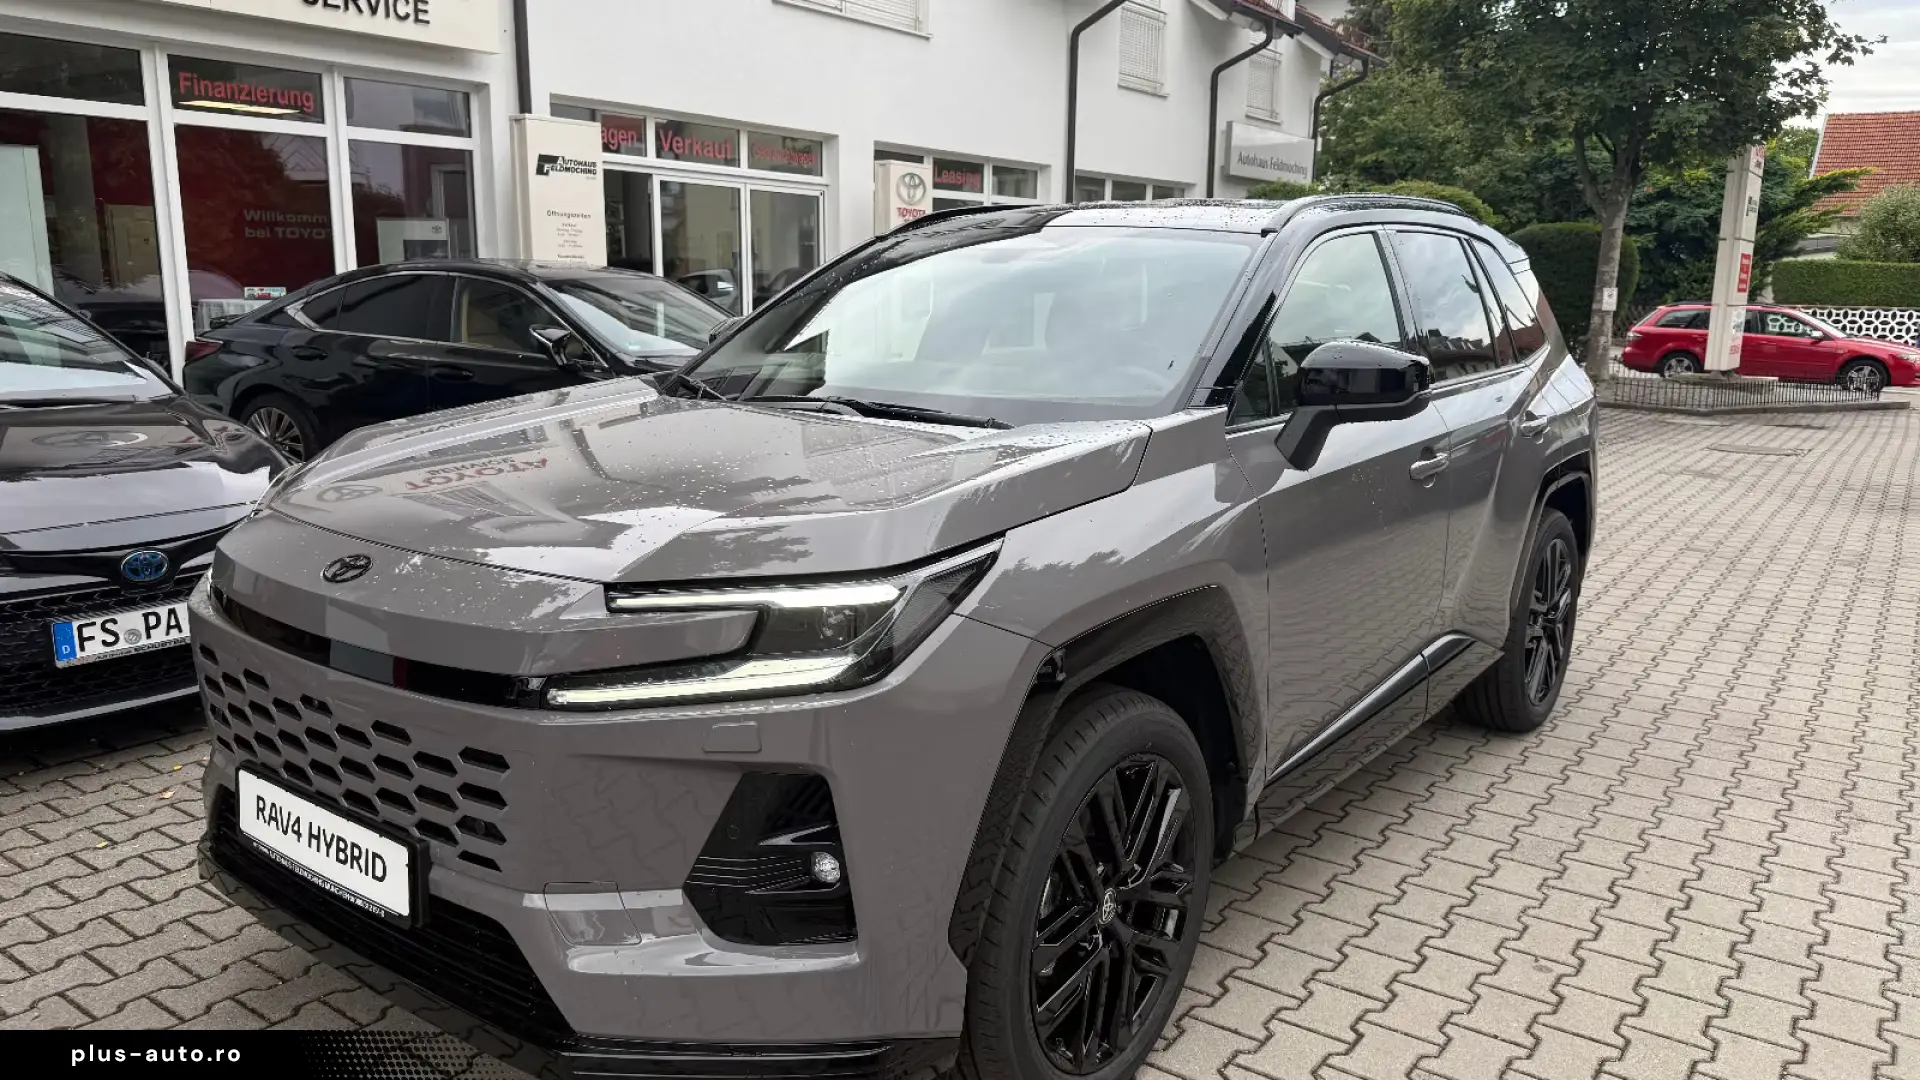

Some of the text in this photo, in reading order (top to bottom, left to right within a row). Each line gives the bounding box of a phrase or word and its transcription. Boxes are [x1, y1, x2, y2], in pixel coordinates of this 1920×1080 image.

[302, 0, 430, 25] RVICE
[179, 72, 315, 112] Finanzierung
[935, 164, 980, 190] Leasing
[245, 227, 270, 238] bei
[77, 607, 183, 652] FS PA
[62, 645, 71, 655] D
[256, 794, 303, 843] RAV4
[307, 821, 387, 883] HYBRID
